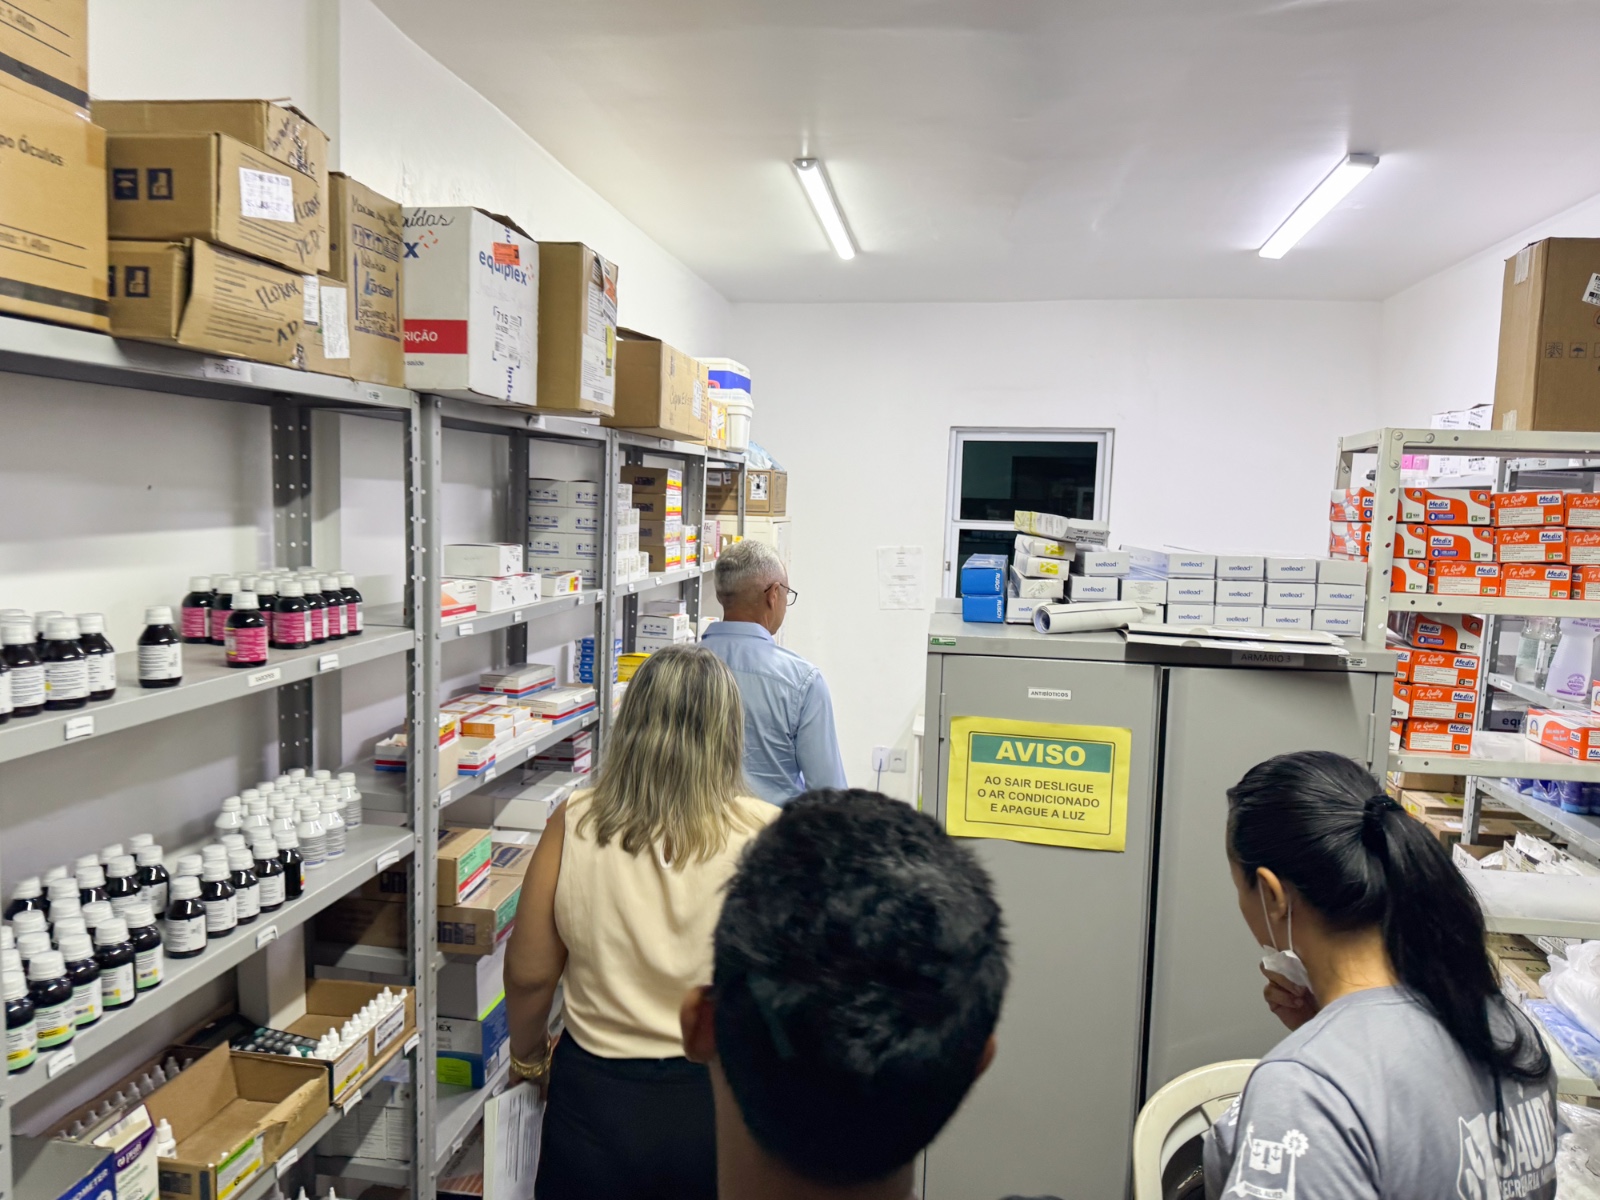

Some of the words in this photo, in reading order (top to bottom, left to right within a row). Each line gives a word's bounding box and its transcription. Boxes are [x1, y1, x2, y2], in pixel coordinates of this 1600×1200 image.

[1539, 495, 1559, 503] Medix
[1547, 570, 1567, 578] Medix
[1419, 624, 1440, 633] Medix
[1241, 653, 1284, 663] ARMÁRIO
[1455, 658, 1475, 666] Medix
[1453, 692, 1474, 700] Medix
[1449, 724, 1470, 732] Medix
[995, 740, 1086, 767] AVISO
[984, 775, 1002, 785] AO
[1004, 777, 1032, 788] SAIR
[1035, 780, 1094, 793] DESLIGUE
[977, 788, 987, 797] O
[988, 790, 1005, 799] AR
[1008, 791, 1100, 808] CONDICIONADO
[990, 803, 998, 812] E
[1000, 804, 1049, 817] APAGUE
[1051, 809, 1060, 818] A
[1062, 810, 1086, 821] LUZ
